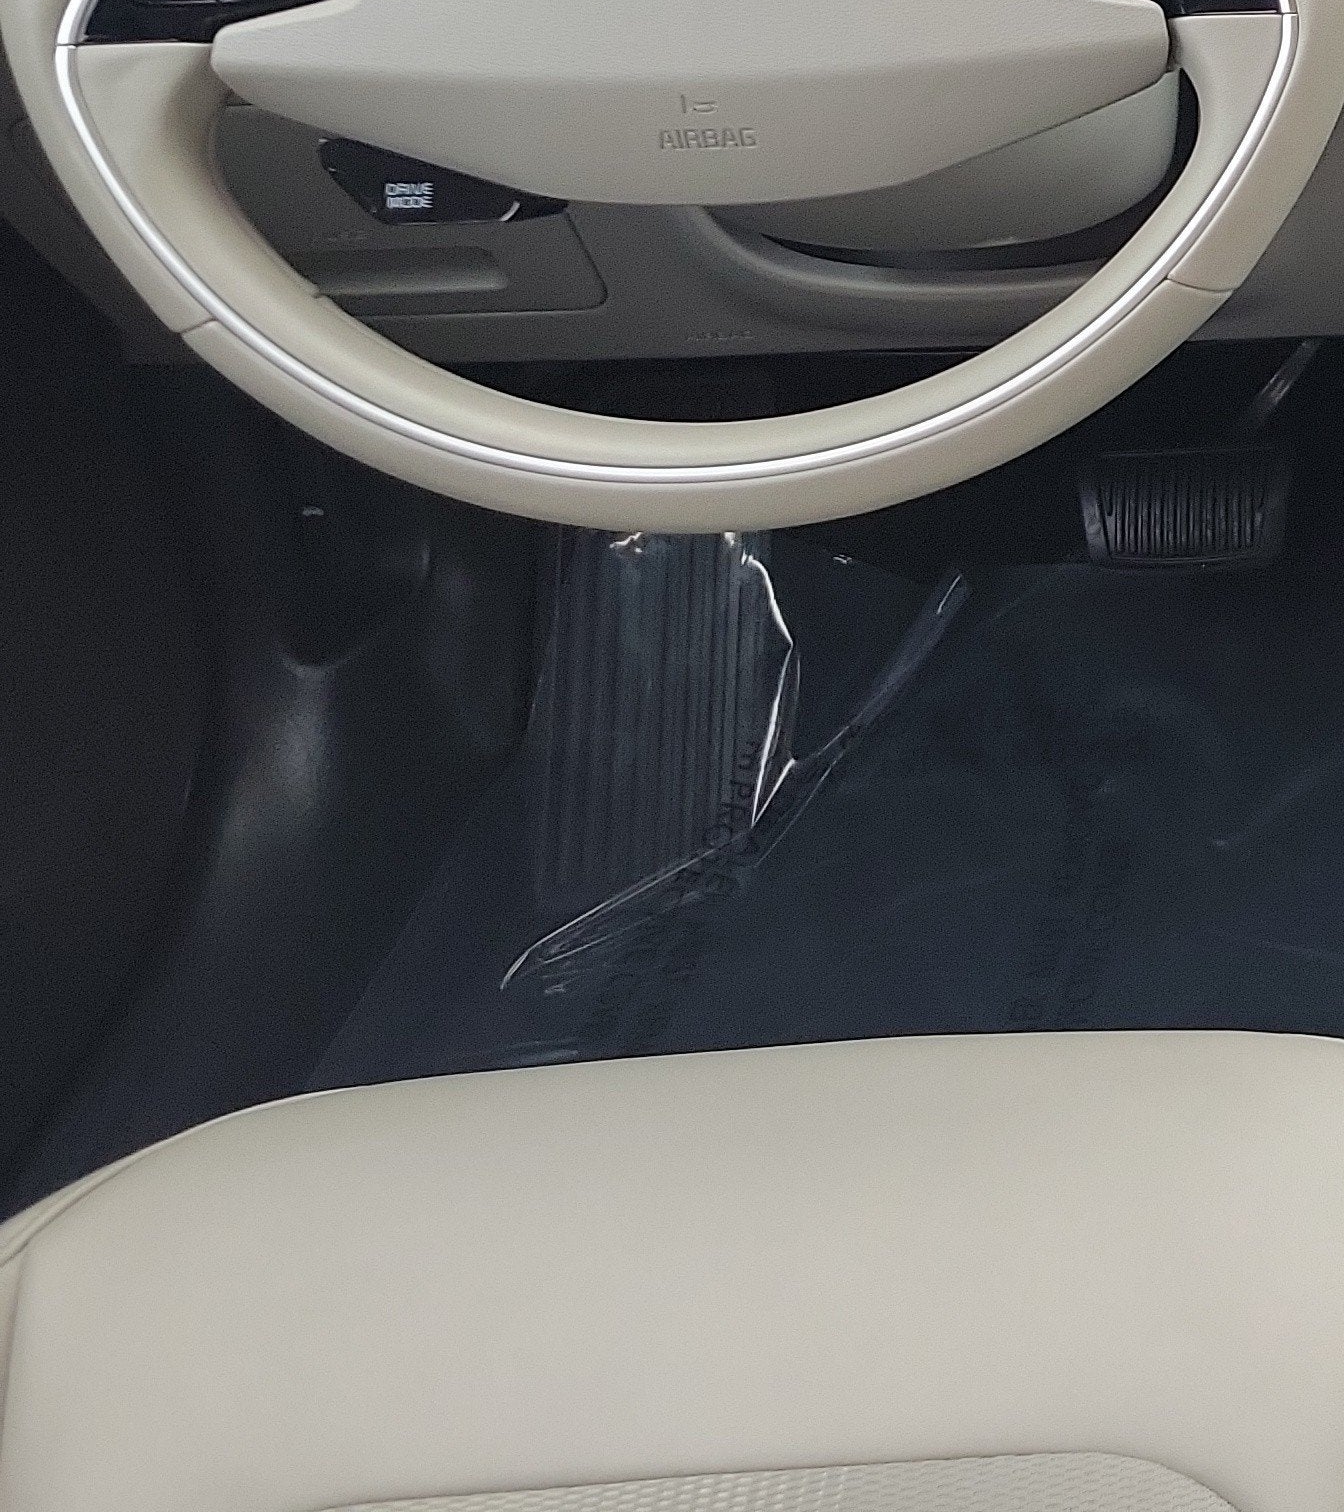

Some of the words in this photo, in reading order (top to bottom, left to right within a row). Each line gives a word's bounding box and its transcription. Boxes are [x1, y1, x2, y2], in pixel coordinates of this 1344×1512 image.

[658, 127, 758, 152] AIRBAG
[384, 182, 434, 194] DRIVE
[385, 196, 434, 209] MODE
